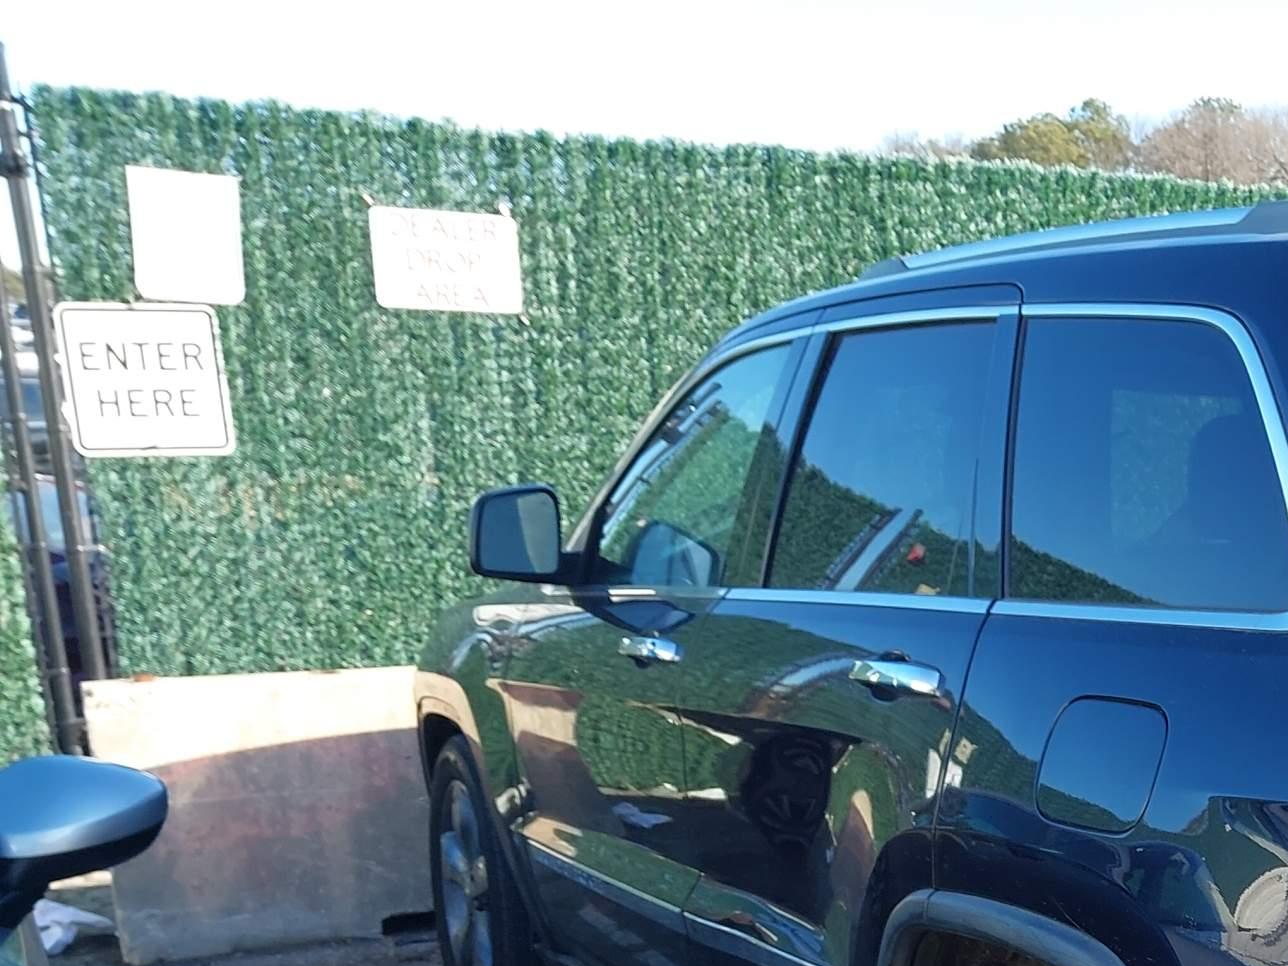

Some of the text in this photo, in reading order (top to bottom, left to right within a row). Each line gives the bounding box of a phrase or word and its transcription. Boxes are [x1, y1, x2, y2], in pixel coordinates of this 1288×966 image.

[389, 212, 497, 241] DEALER
[406, 248, 481, 273] DROP
[416, 281, 490, 308] AREA
[79, 342, 205, 371] ENTER
[97, 389, 201, 417] HERE
